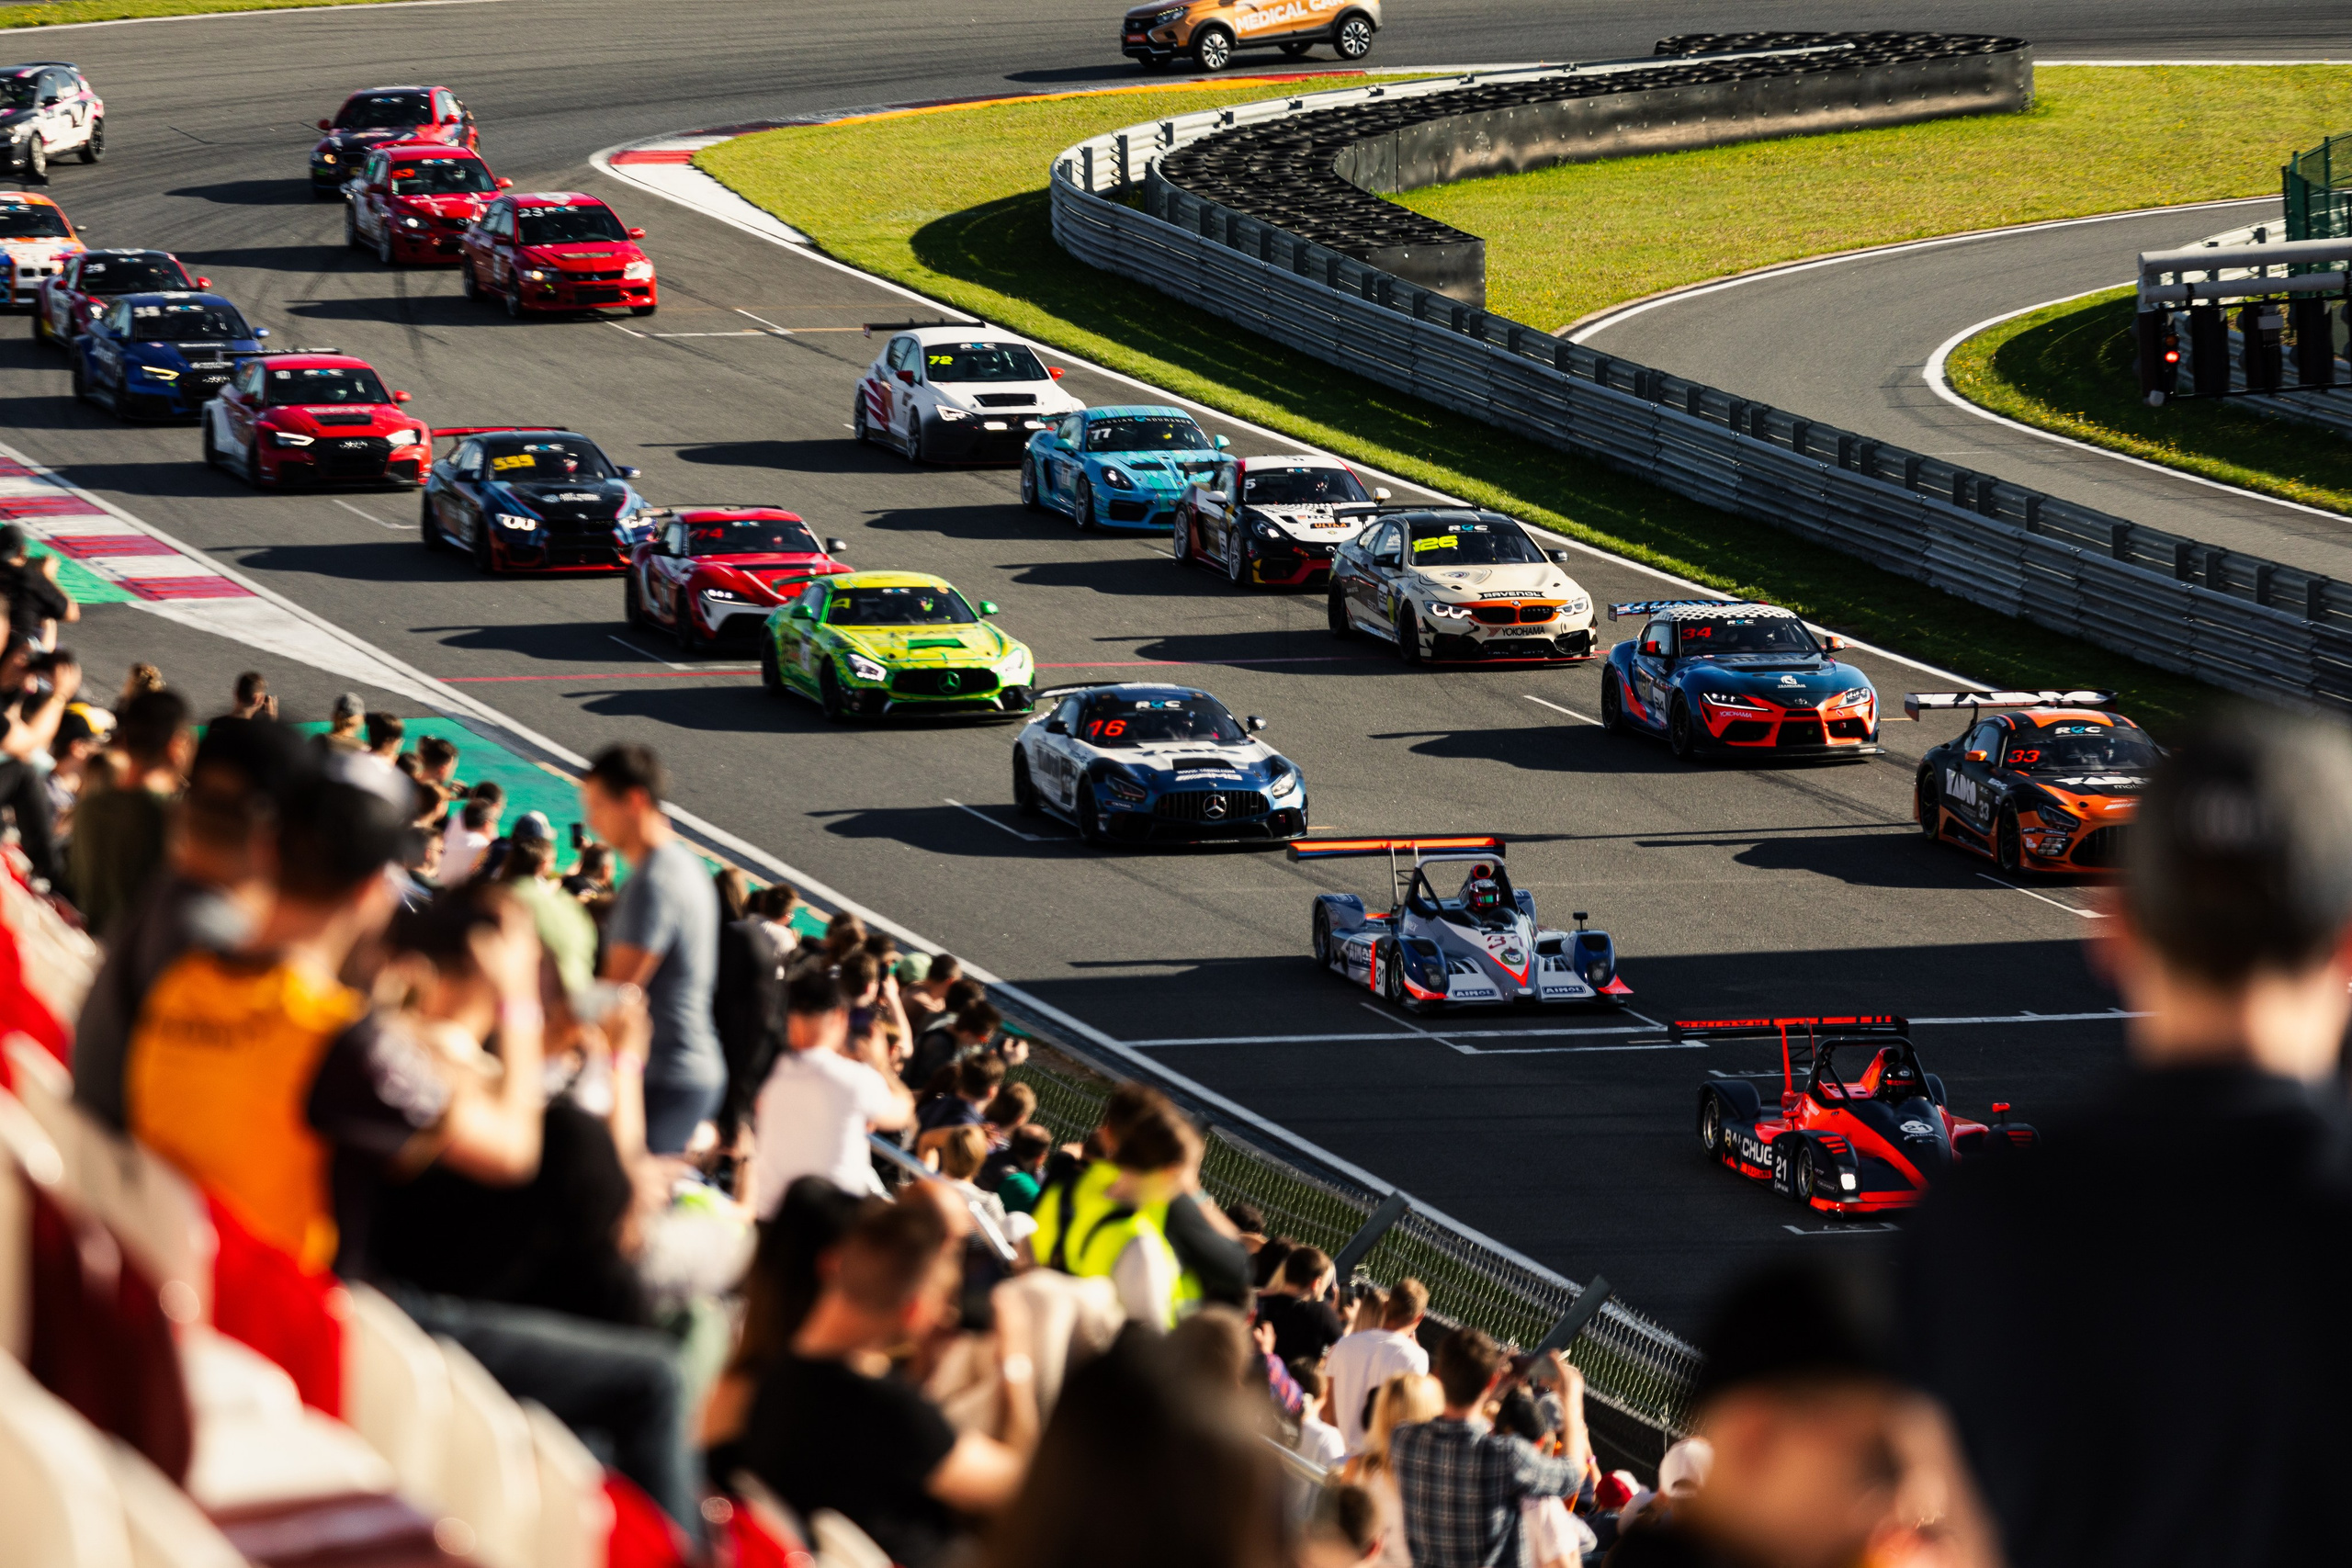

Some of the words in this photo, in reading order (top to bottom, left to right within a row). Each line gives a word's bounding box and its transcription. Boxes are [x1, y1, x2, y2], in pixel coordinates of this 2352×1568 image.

[1235, 1, 1308, 34] MEDICAL
[518, 208, 546, 218] 23
[928, 355, 954, 366] 72
[1091, 427, 1113, 441] 77
[1245, 479, 1257, 490] 5
[1411, 535, 1458, 553] 126
[1483, 591, 1542, 599] RAVENOL
[1502, 626, 1545, 637] YOKOHAMA
[1681, 626, 1713, 640] 34
[1089, 719, 1127, 737] 16
[2007, 750, 2041, 763] 33
[1979, 799, 1990, 821] 33
[1487, 935, 1524, 950] 31
[1376, 966, 1385, 988] 31
[1456, 989, 1494, 998] AIMOL
[1545, 986, 1583, 994] AIMOL
[1775, 1155, 1788, 1182] 21
